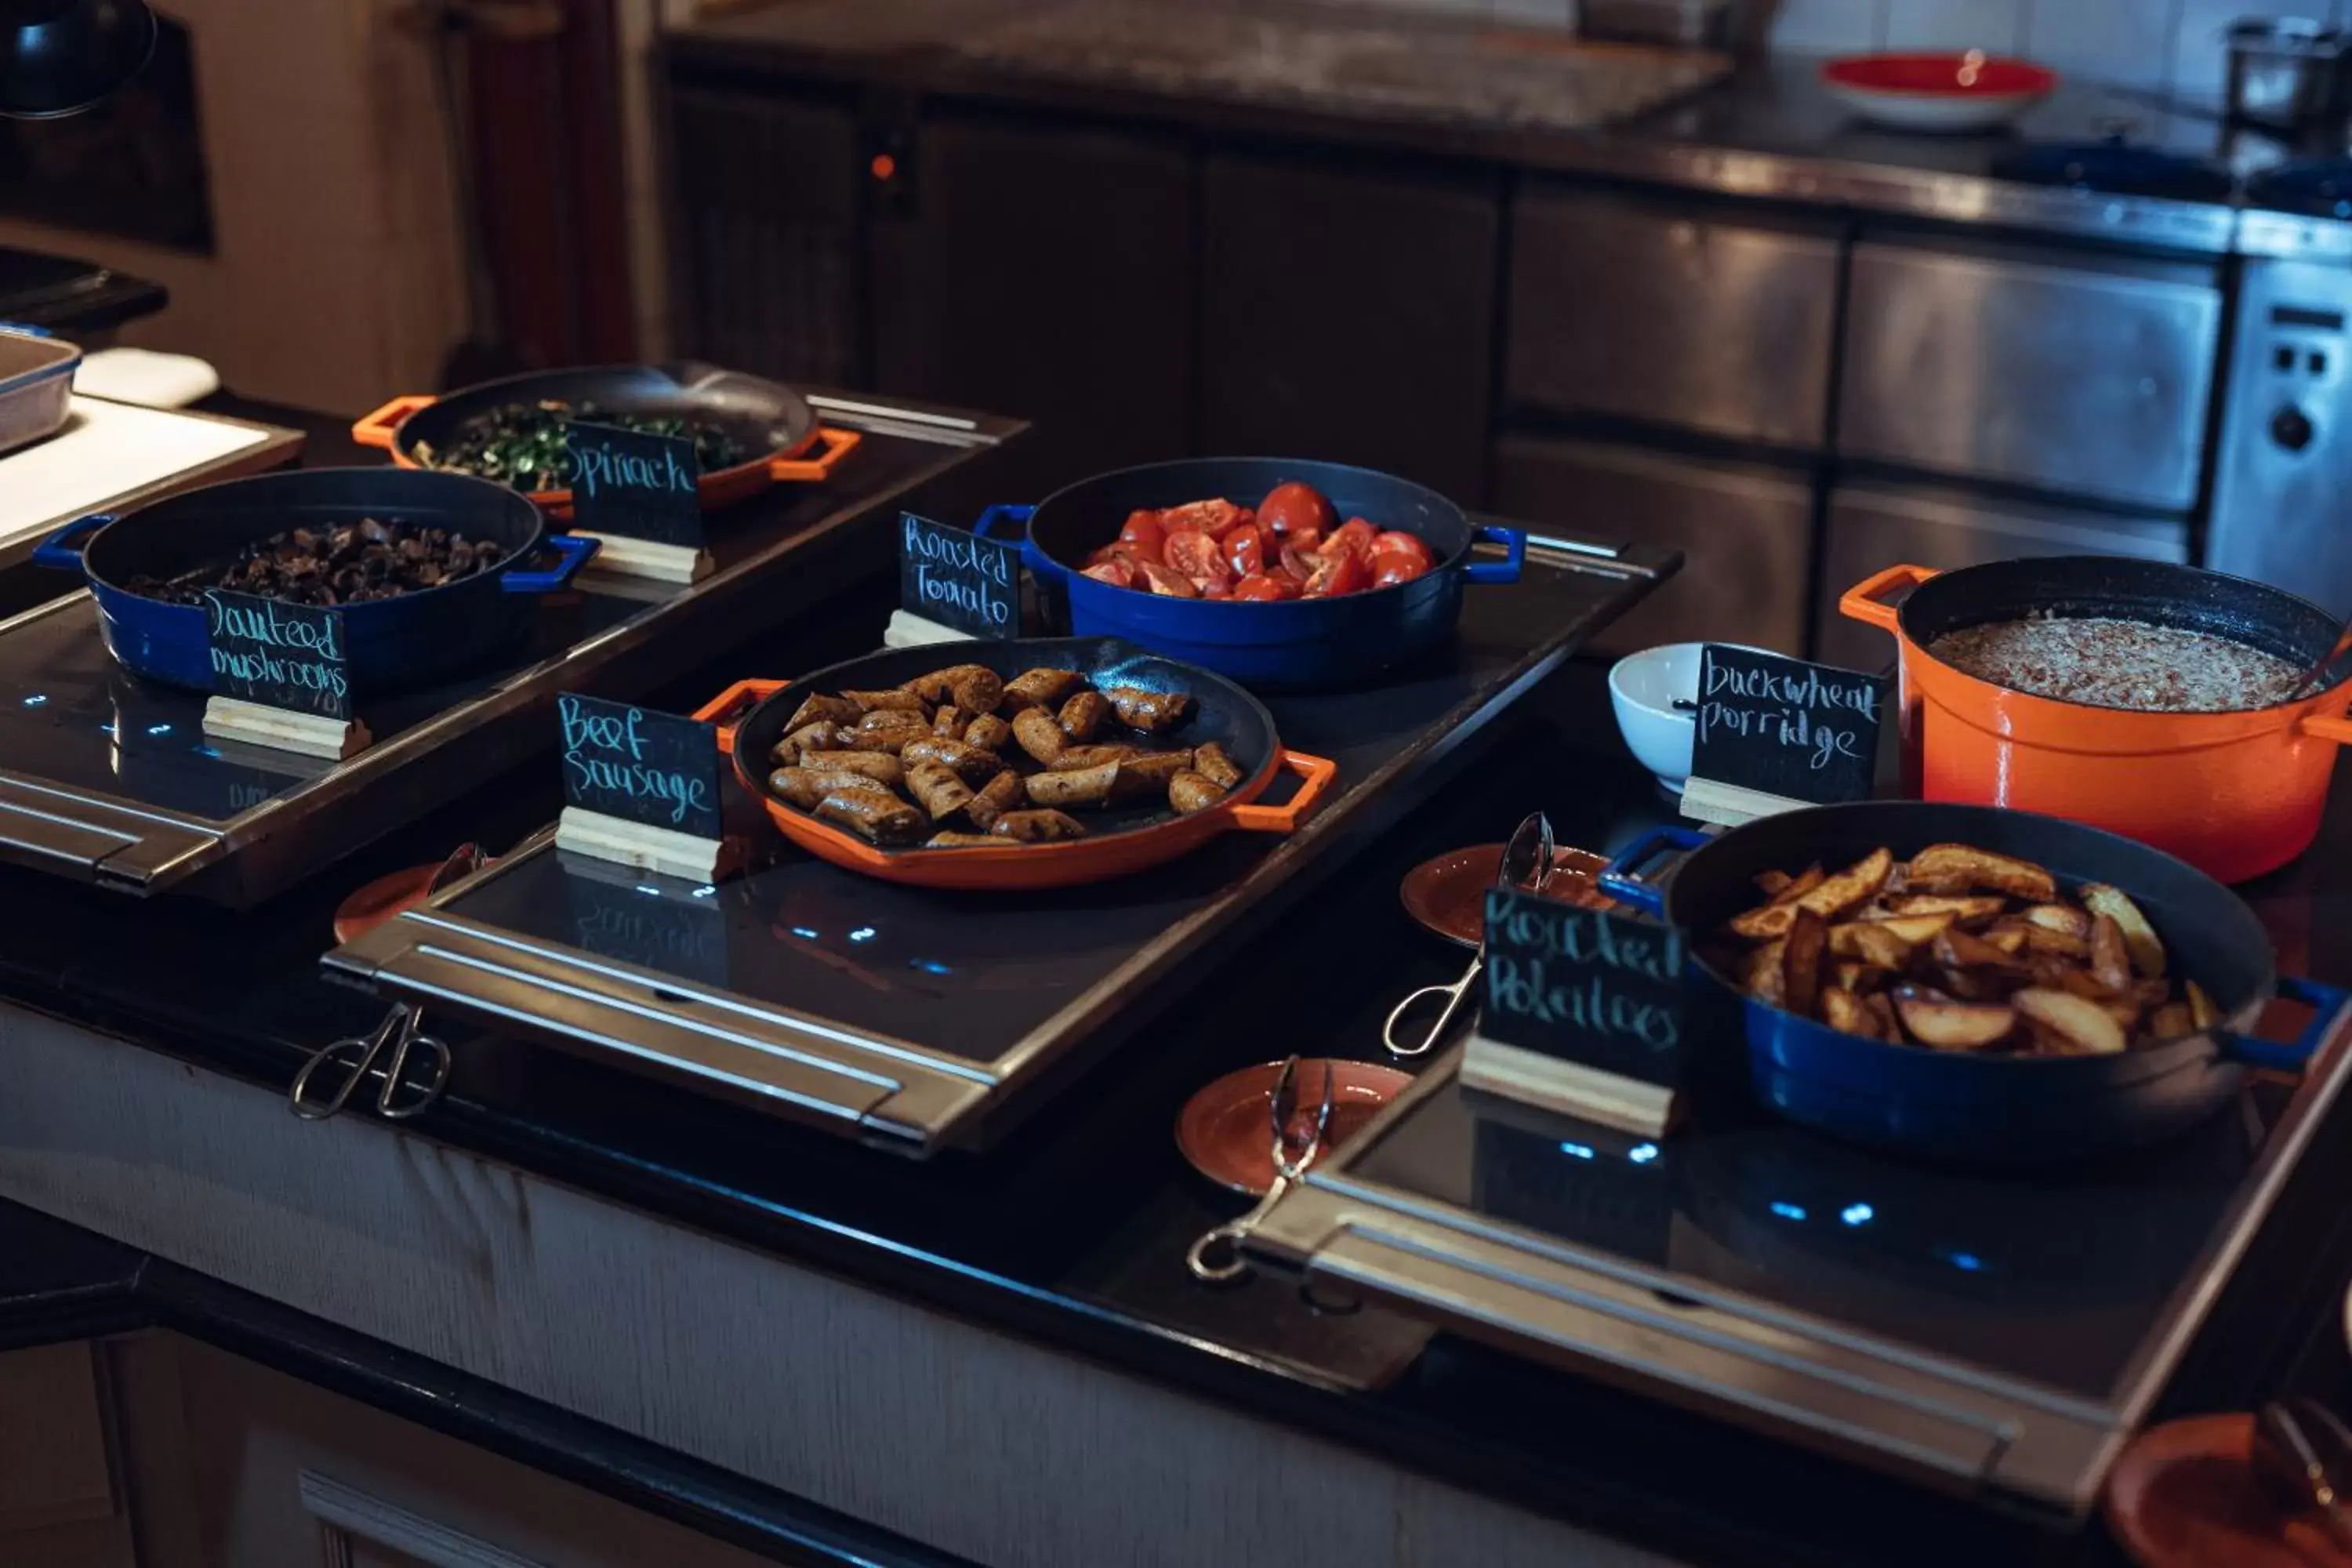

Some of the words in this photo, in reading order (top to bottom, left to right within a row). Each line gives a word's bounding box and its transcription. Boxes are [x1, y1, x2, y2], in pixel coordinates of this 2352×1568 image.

[565, 431, 696, 499] Spinach
[906, 517, 1010, 588] Roasted
[913, 563, 1008, 625] Tomato
[1707, 649, 1882, 724] buckwheat
[558, 697, 652, 760] Beef
[564, 750, 713, 822] Sausage
